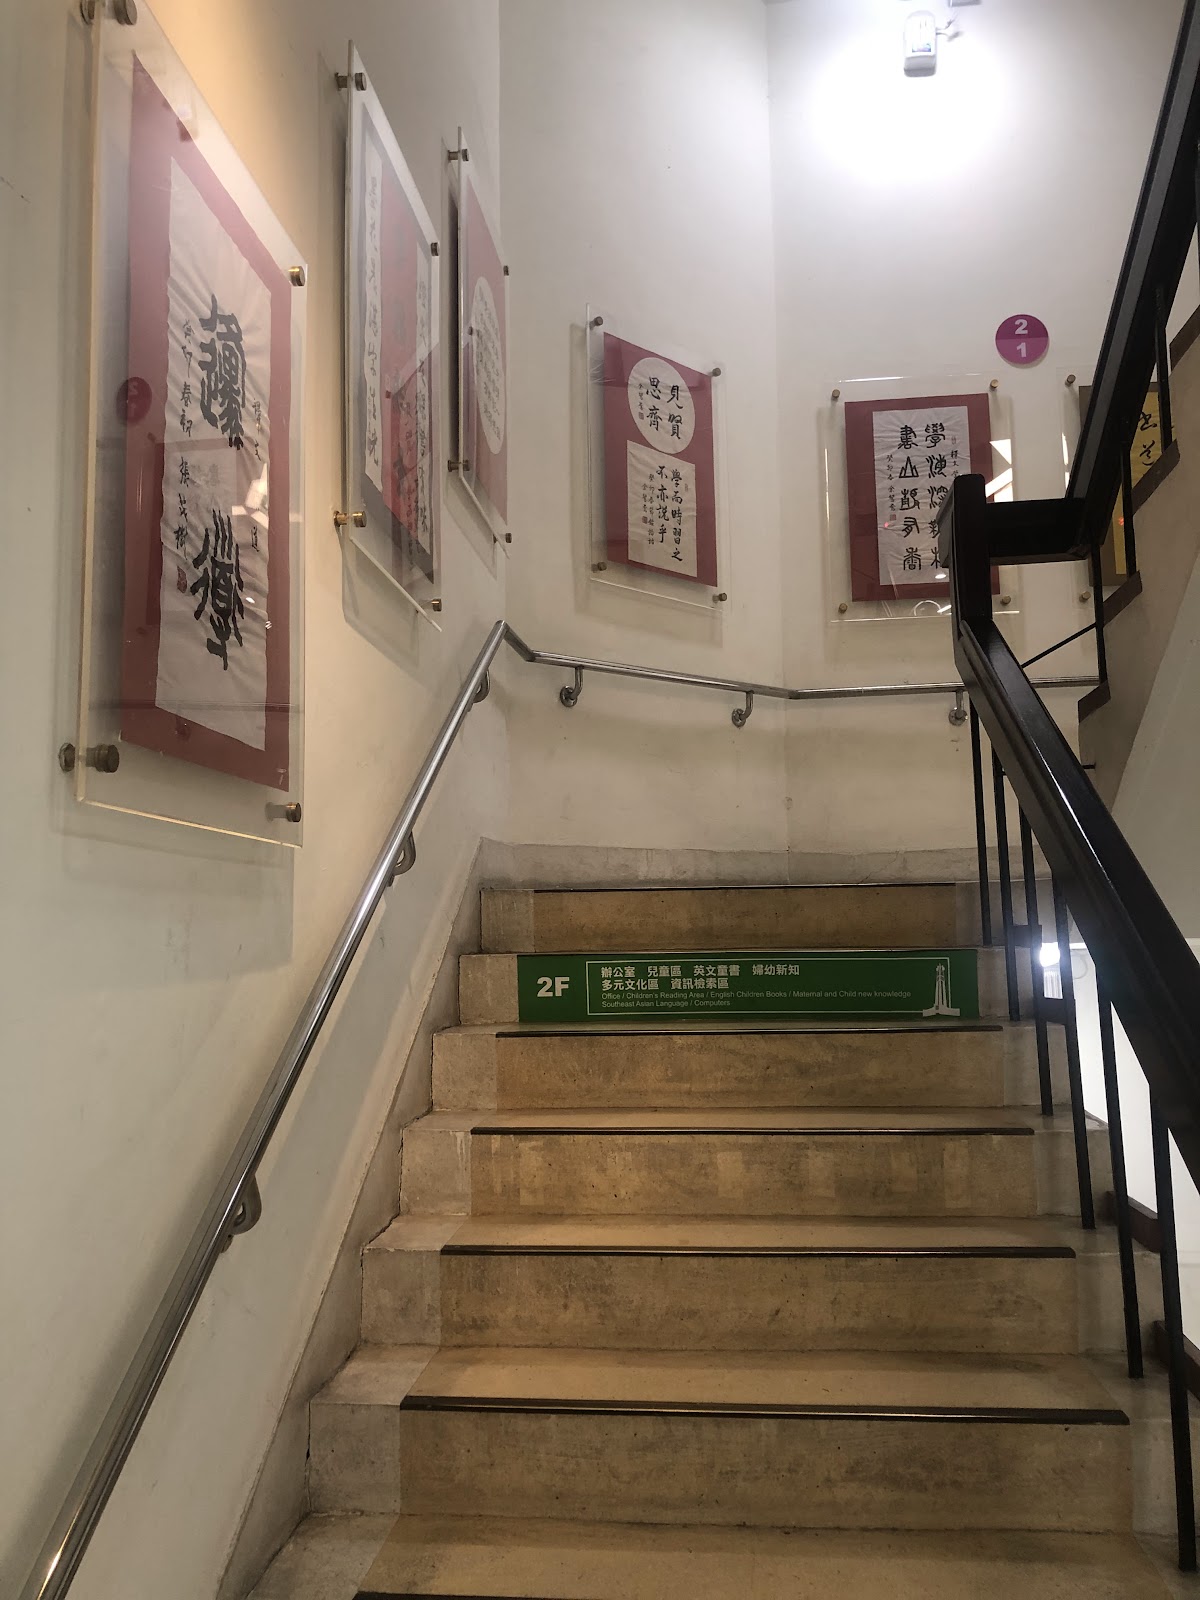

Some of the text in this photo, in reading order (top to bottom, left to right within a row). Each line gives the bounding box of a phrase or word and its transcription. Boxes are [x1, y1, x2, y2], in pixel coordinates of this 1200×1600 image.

[1014, 318, 1028, 335] 2
[1016, 342, 1027, 358] 1
[646, 376, 662, 432] 思齊
[666, 384, 683, 440] 見賢
[656, 465, 669, 544] 不亦說乎
[671, 468, 683, 562] 學而時習之
[601, 963, 800, 979] 辦公室 兒童區 英文童書 婦幼新知
[536, 976, 570, 998] 2F
[601, 977, 729, 991] 多元文化區 資訊檢索區
[710, 991, 735, 999] English
[766, 990, 787, 998] Books
[793, 990, 822, 998] Maternal
[824, 990, 837, 998] and
[839, 990, 857, 998] Child
[874, 990, 911, 999] knowledge
[601, 1000, 635, 1008] Southeast
[655, 1000, 689, 1008] Language
